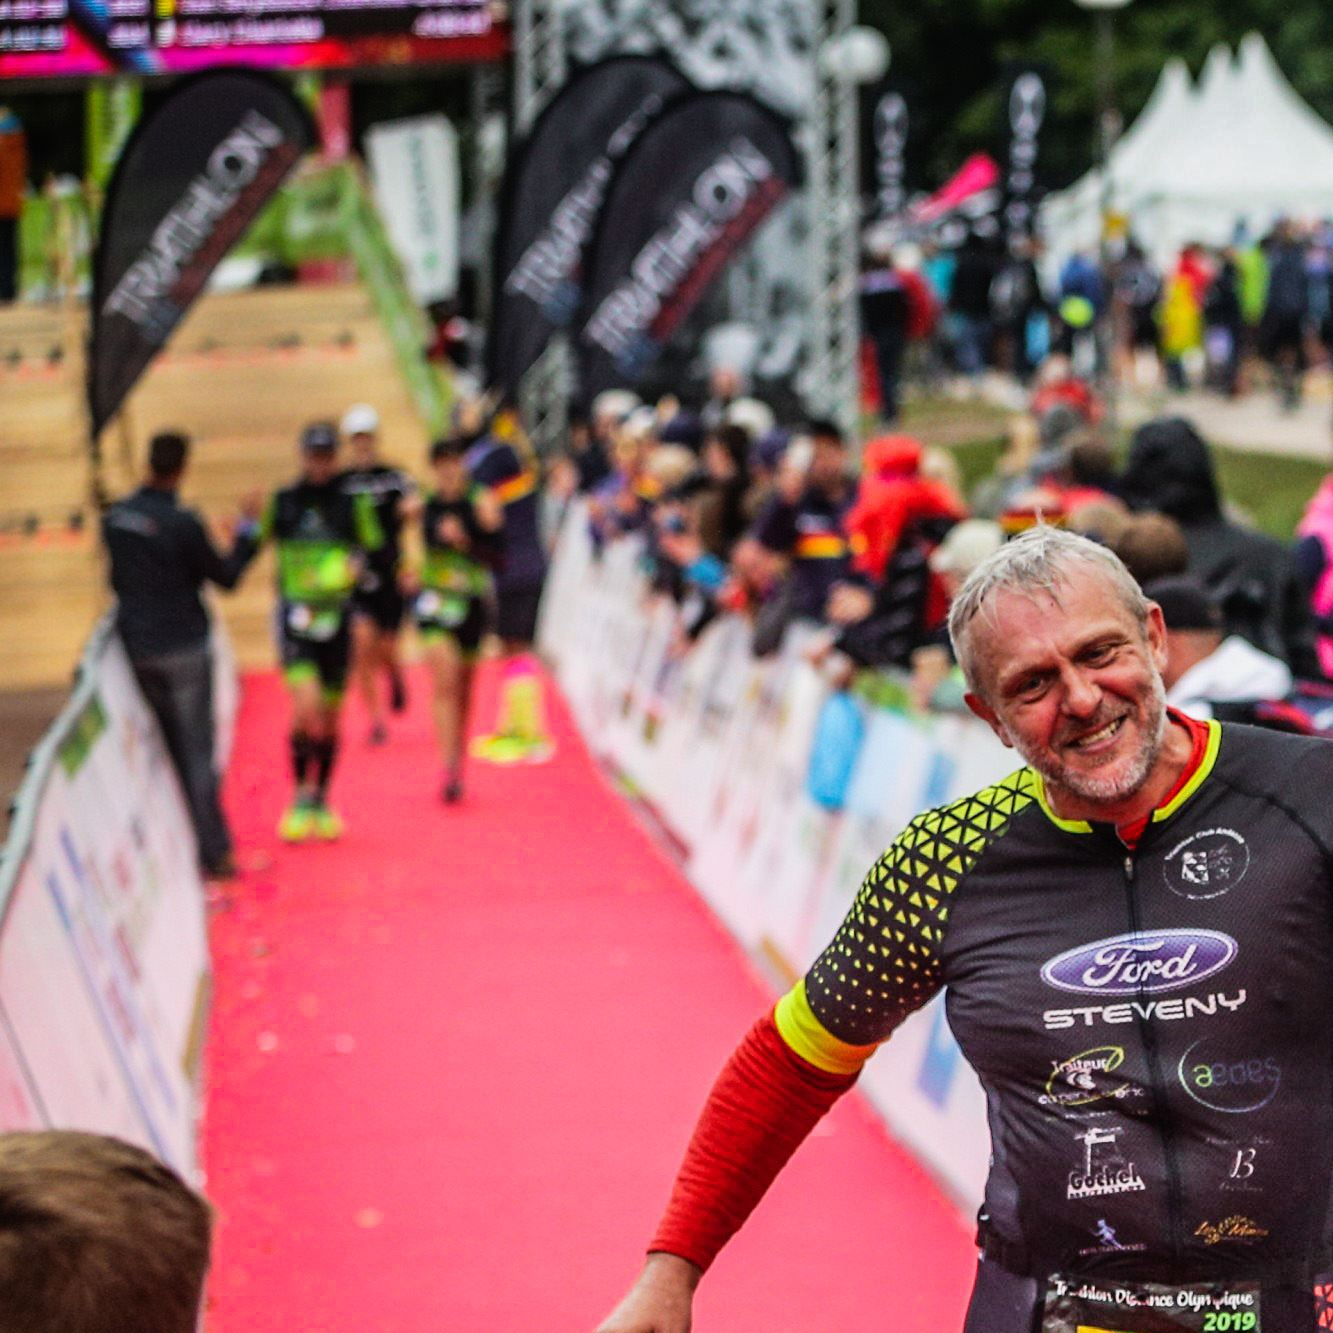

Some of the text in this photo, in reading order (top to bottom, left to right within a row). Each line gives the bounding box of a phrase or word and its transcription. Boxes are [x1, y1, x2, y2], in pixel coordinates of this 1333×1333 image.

[102, 110, 285, 324] TRIATHLON
[582, 135, 773, 356] TRIATHLON
[1082, 940, 1199, 987] Ford
[1043, 989, 1247, 1030] STEVENY
[1055, 1279, 1113, 1303] Trthlon
[1203, 1312, 1257, 1332] 2019
